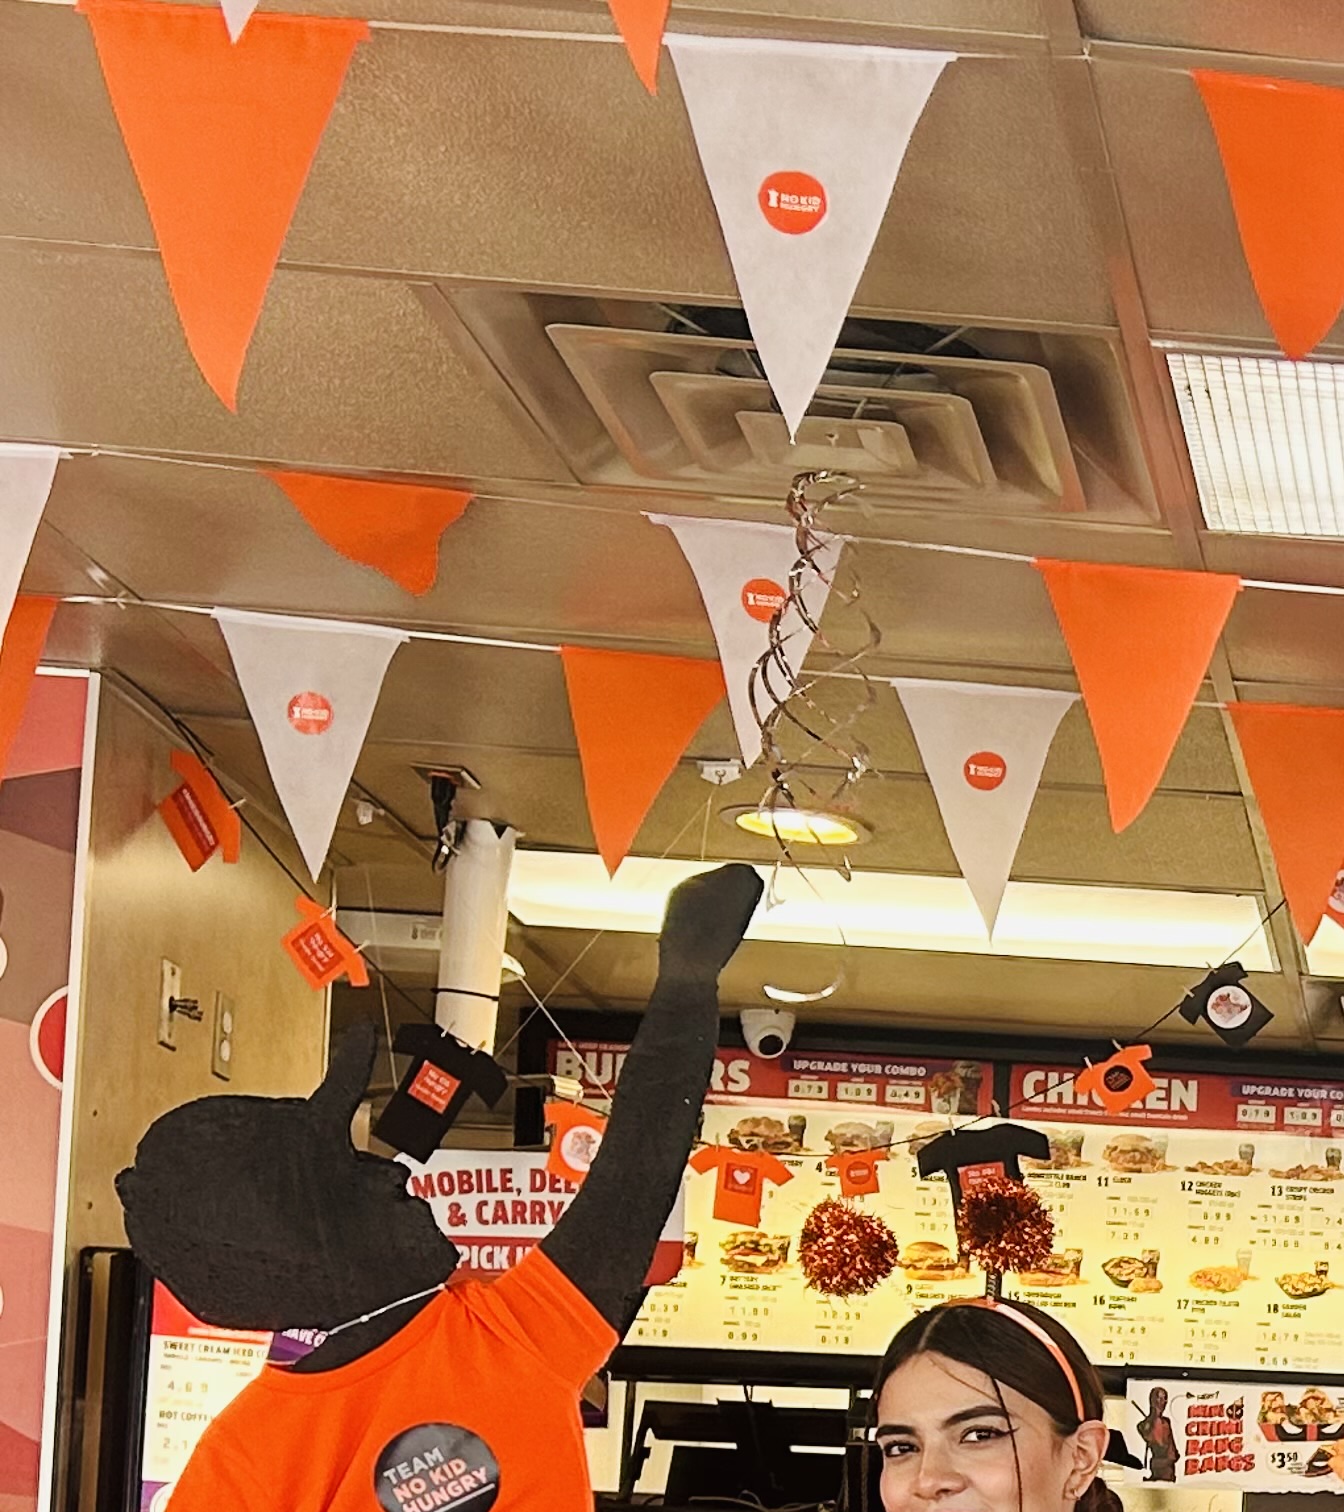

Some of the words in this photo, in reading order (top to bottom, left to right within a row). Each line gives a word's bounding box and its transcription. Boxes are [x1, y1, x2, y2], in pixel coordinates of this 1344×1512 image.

[411, 1168, 522, 1198] MOBILE,
[1097, 1175, 1109, 1187] 11
[1180, 1180, 1194, 1191] 12
[1270, 1185, 1283, 1197] 13
[448, 1202, 468, 1227] &
[475, 1200, 566, 1226] CARRY
[1092, 1294, 1106, 1306] 16
[1176, 1298, 1190, 1310] 17
[1266, 1303, 1279, 1314] 18
[1185, 1437, 1244, 1456] BANG
[384, 1447, 445, 1485] TEAM
[1184, 1453, 1256, 1476] BANGS
[392, 1477, 427, 1504] NO
[429, 1458, 468, 1487] KID
